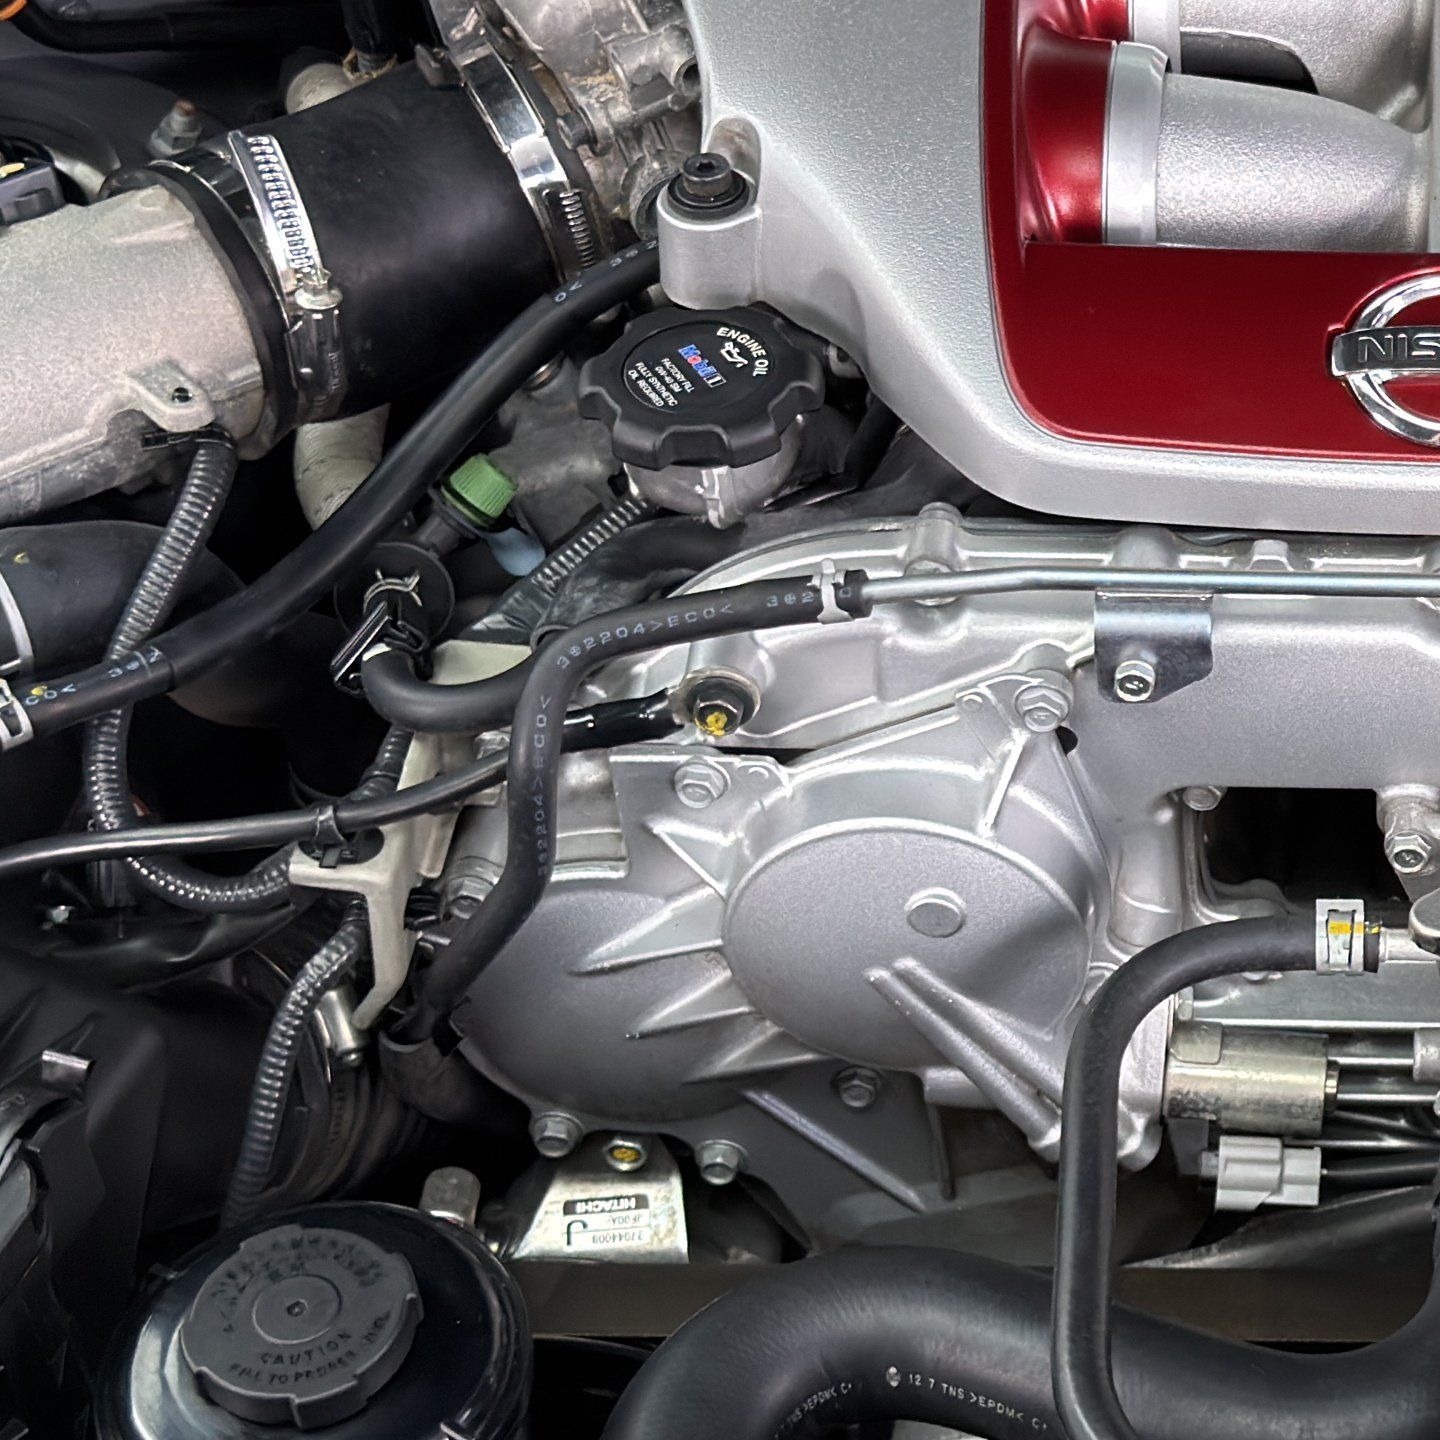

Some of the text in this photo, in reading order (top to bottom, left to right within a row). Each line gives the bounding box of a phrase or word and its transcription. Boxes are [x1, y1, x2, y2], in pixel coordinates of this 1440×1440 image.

[678, 344, 717, 378] Mobil
[716, 326, 769, 377] ENGINE OIL
[576, 1197, 636, 1214] HITACHI
[260, 1331, 353, 1365] CAUTION
[941, 1382, 965, 1400] TNS
